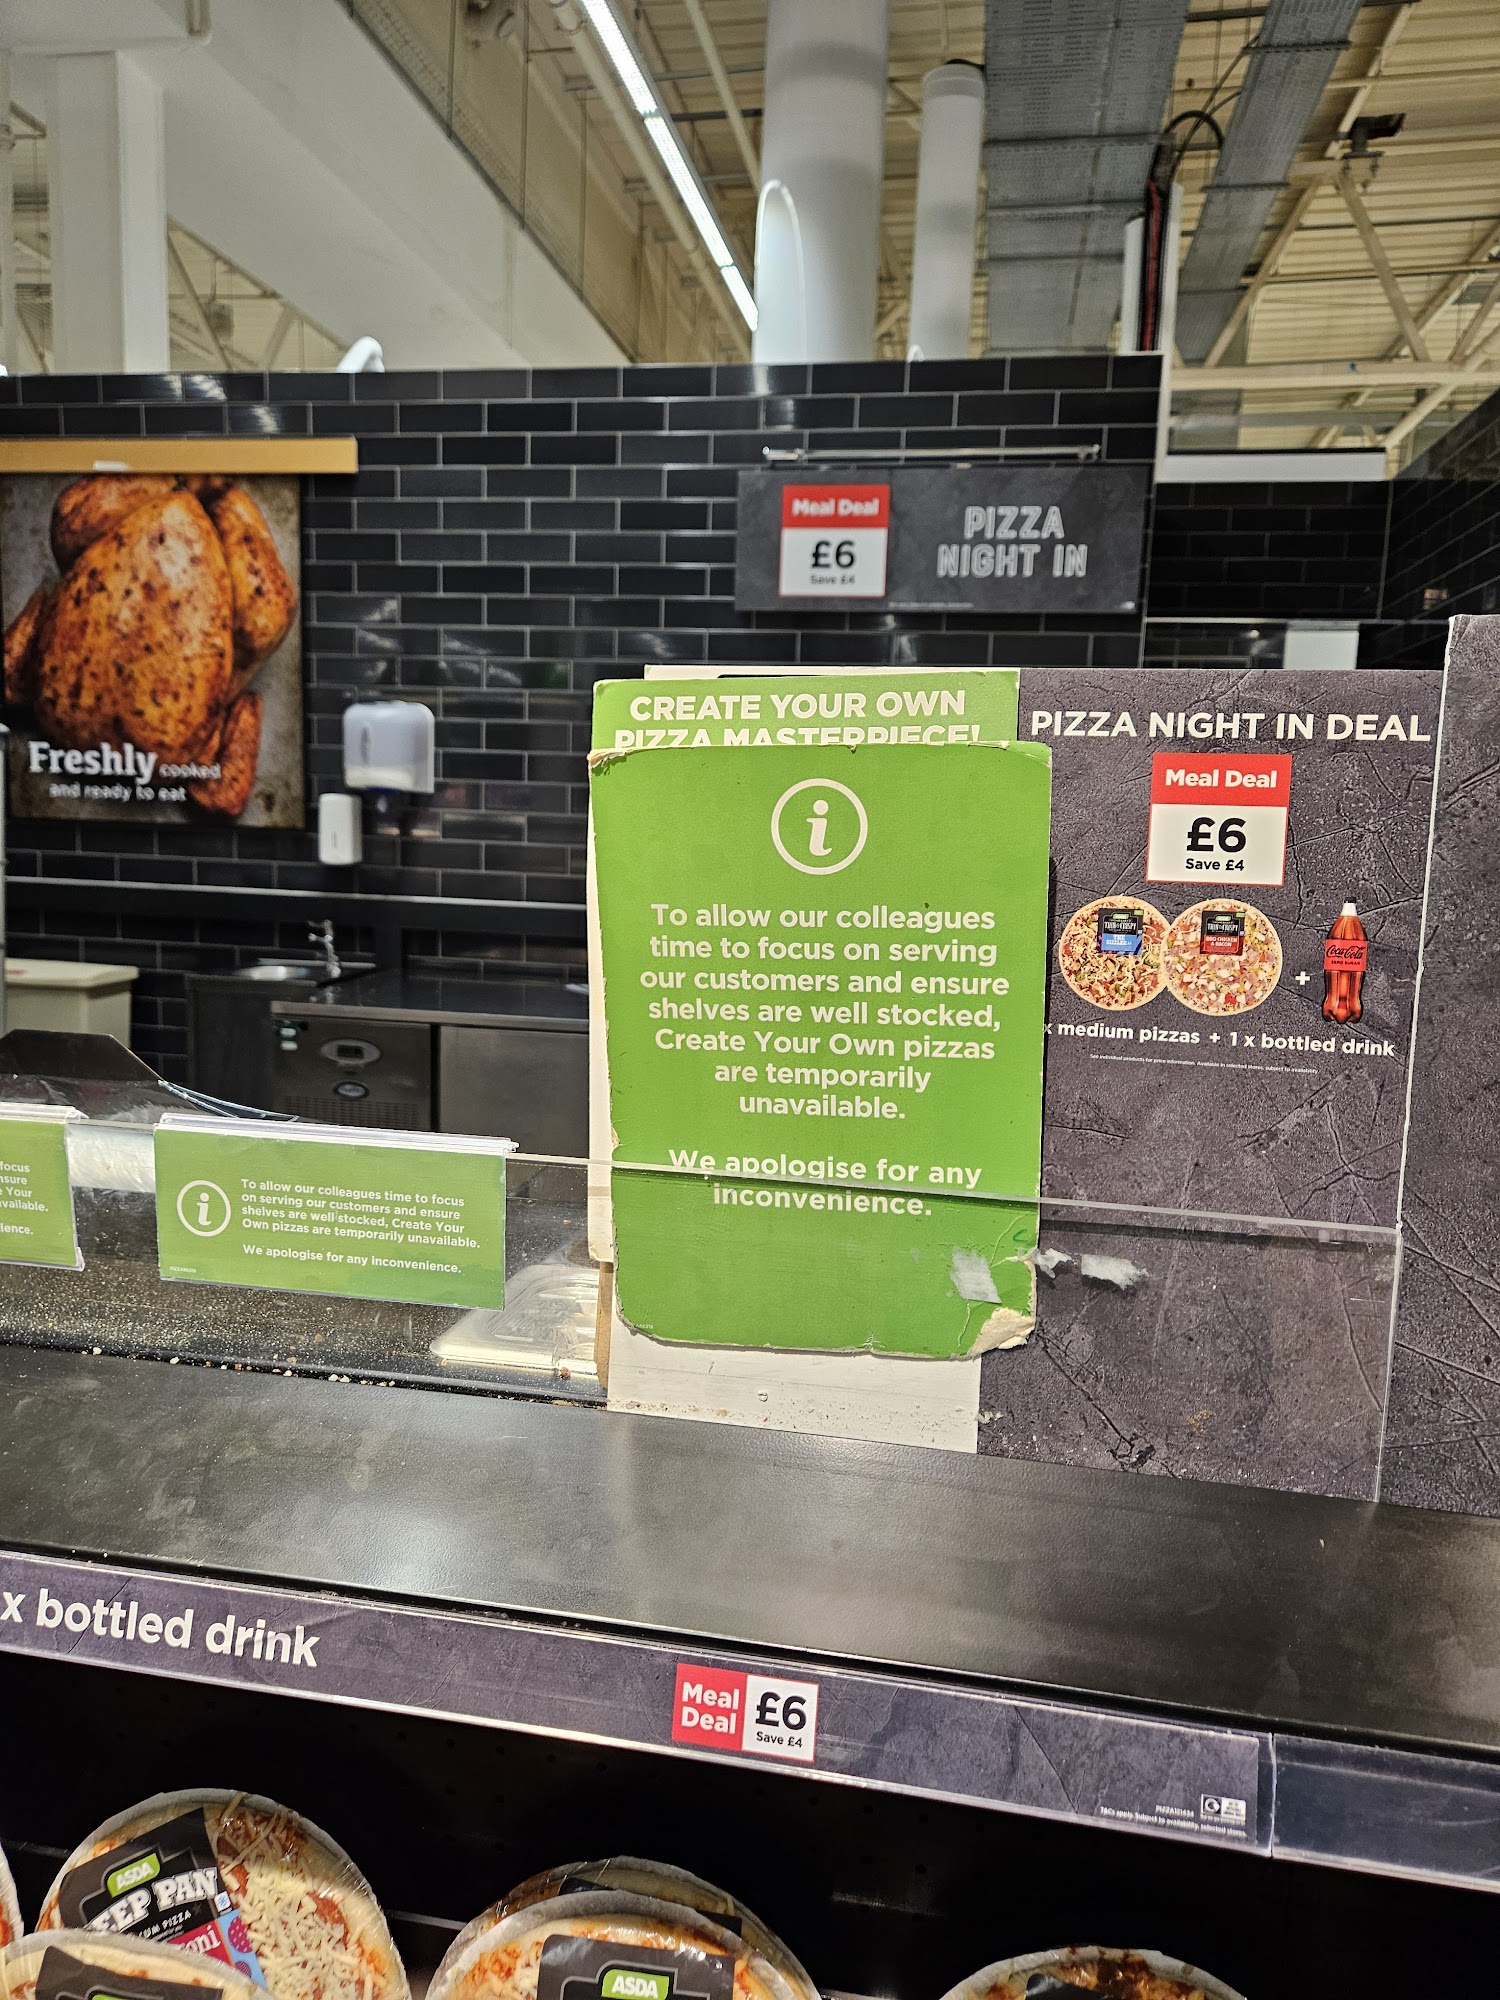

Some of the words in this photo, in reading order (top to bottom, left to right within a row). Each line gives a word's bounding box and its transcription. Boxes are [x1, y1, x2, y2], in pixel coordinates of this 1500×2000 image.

[792, 498, 835, 516] Meal
[838, 498, 879, 516] Deal
[964, 505, 1065, 540] PIZZA
[811, 540, 855, 568] £6
[936, 543, 1041, 578] NIGHT
[1052, 543, 1088, 578] IN
[630, 695, 760, 721] CREATE
[769, 692, 867, 719] YOUR
[876, 690, 965, 717] OWN
[615, 729, 711, 749] PIZZA
[723, 725, 981, 746] MASTERPIECE!
[1031, 710, 1137, 737] PIZZA
[1149, 712, 1260, 739] NIGHT
[1276, 713, 1314, 740] IN
[1327, 714, 1431, 742] DEAL
[28, 741, 159, 785] Freshly
[159, 762, 222, 780] cooked
[49, 782, 81, 798] and
[84, 783, 132, 802] ready
[135, 784, 155, 800] to
[158, 786, 187, 801] eat
[1165, 769, 1219, 788] Meal
[1224, 770, 1277, 789] Deal
[1186, 817, 1247, 854] £6
[1185, 858, 1221, 871] Save
[1225, 859, 1245, 872] £4
[651, 904, 687, 926] To
[696, 904, 771, 927] allow
[780, 910, 828, 928] our
[836, 905, 995, 934] colleagues
[650, 935, 712, 958] time
[720, 938, 750, 959] to
[758, 936, 835, 960] focus
[843, 943, 880, 961] on
[889, 938, 997, 966] serving
[640, 971, 686, 989] our
[694, 970, 840, 992] customers
[848, 971, 901, 993] and
[911, 976, 1010, 995] ensure
[649, 997, 750, 1021] shelves
[757, 1004, 802, 1022] are
[810, 1002, 868, 1024] well
[876, 1003, 1000, 1032] stocked,
[655, 1029, 746, 1052] Create
[754, 1031, 820, 1055] Your
[829, 1033, 895, 1056] Own
[904, 1035, 995, 1061] pizzas
[1058, 1022, 1134, 1040] medium
[1139, 1026, 1201, 1044] pizzas
[1208, 1033, 1221, 1044] +
[1230, 1032, 1237, 1047] 1
[1243, 1036, 1255, 1048] x
[1261, 1033, 1336, 1053] bottled
[1342, 1038, 1396, 1057] drink
[714, 1064, 758, 1082] are
[766, 1063, 931, 1093] temporarily
[739, 1094, 905, 1119] unavailable.
[0, 1161, 30, 1172] focus
[668, 1150, 715, 1170] We
[725, 1154, 866, 1180] apologise
[877, 1159, 920, 1182] for
[928, 1165, 982, 1189] any
[6, 1187, 32, 1197] Your
[241, 1179, 256, 1189] To
[260, 1181, 291, 1192] allow
[295, 1185, 315, 1194] our
[318, 1186, 381, 1200] colleagues
[384, 1191, 411, 1202] time
[415, 1194, 428, 1203] to
[432, 1194, 465, 1206] focus
[242, 1194, 256, 1202] on
[260, 1195, 302, 1208] serving
[306, 1199, 326, 1208] our
[330, 1201, 390, 1214] customers
[394, 1206, 416, 1216] and
[420, 1209, 460, 1219] ensure
[713, 1183, 931, 1215] inconvenience.
[0, 1223, 33, 1235] ience.
[242, 1205, 285, 1218] shelves
[289, 1211, 307, 1219] are
[311, 1212, 334, 1222] well
[338, 1214, 388, 1228] stocked,
[392, 1218, 432, 1230] Create
[436, 1222, 464, 1233] Your
[242, 1218, 269, 1229] Own
[272, 1221, 309, 1233] pizzas
[312, 1227, 331, 1235] are
[334, 1227, 404, 1243] temporarily
[408, 1233, 480, 1248] unavailable.
[243, 1244, 263, 1255] We
[266, 1248, 323, 1260] apologise
[326, 1252, 343, 1262] for
[347, 1256, 368, 1266] any
[372, 1256, 461, 1273] inconvenience.
[0, 1591, 25, 1623] x
[37, 1588, 194, 1649] bottled
[205, 1615, 320, 1668] drink
[682, 1682, 740, 1710] Meal
[681, 1706, 737, 1734] Deal
[755, 1691, 807, 1731] £6
[756, 1731, 784, 1745] Save
[787, 1736, 803, 1748] £4
[116, 1861, 155, 1891] ASDA
[84, 1887, 151, 1933] EEP
[151, 1867, 217, 1912] PAN
[162, 1910, 191, 1929] PIZZA
[611, 1974, 659, 1999] ASDA
